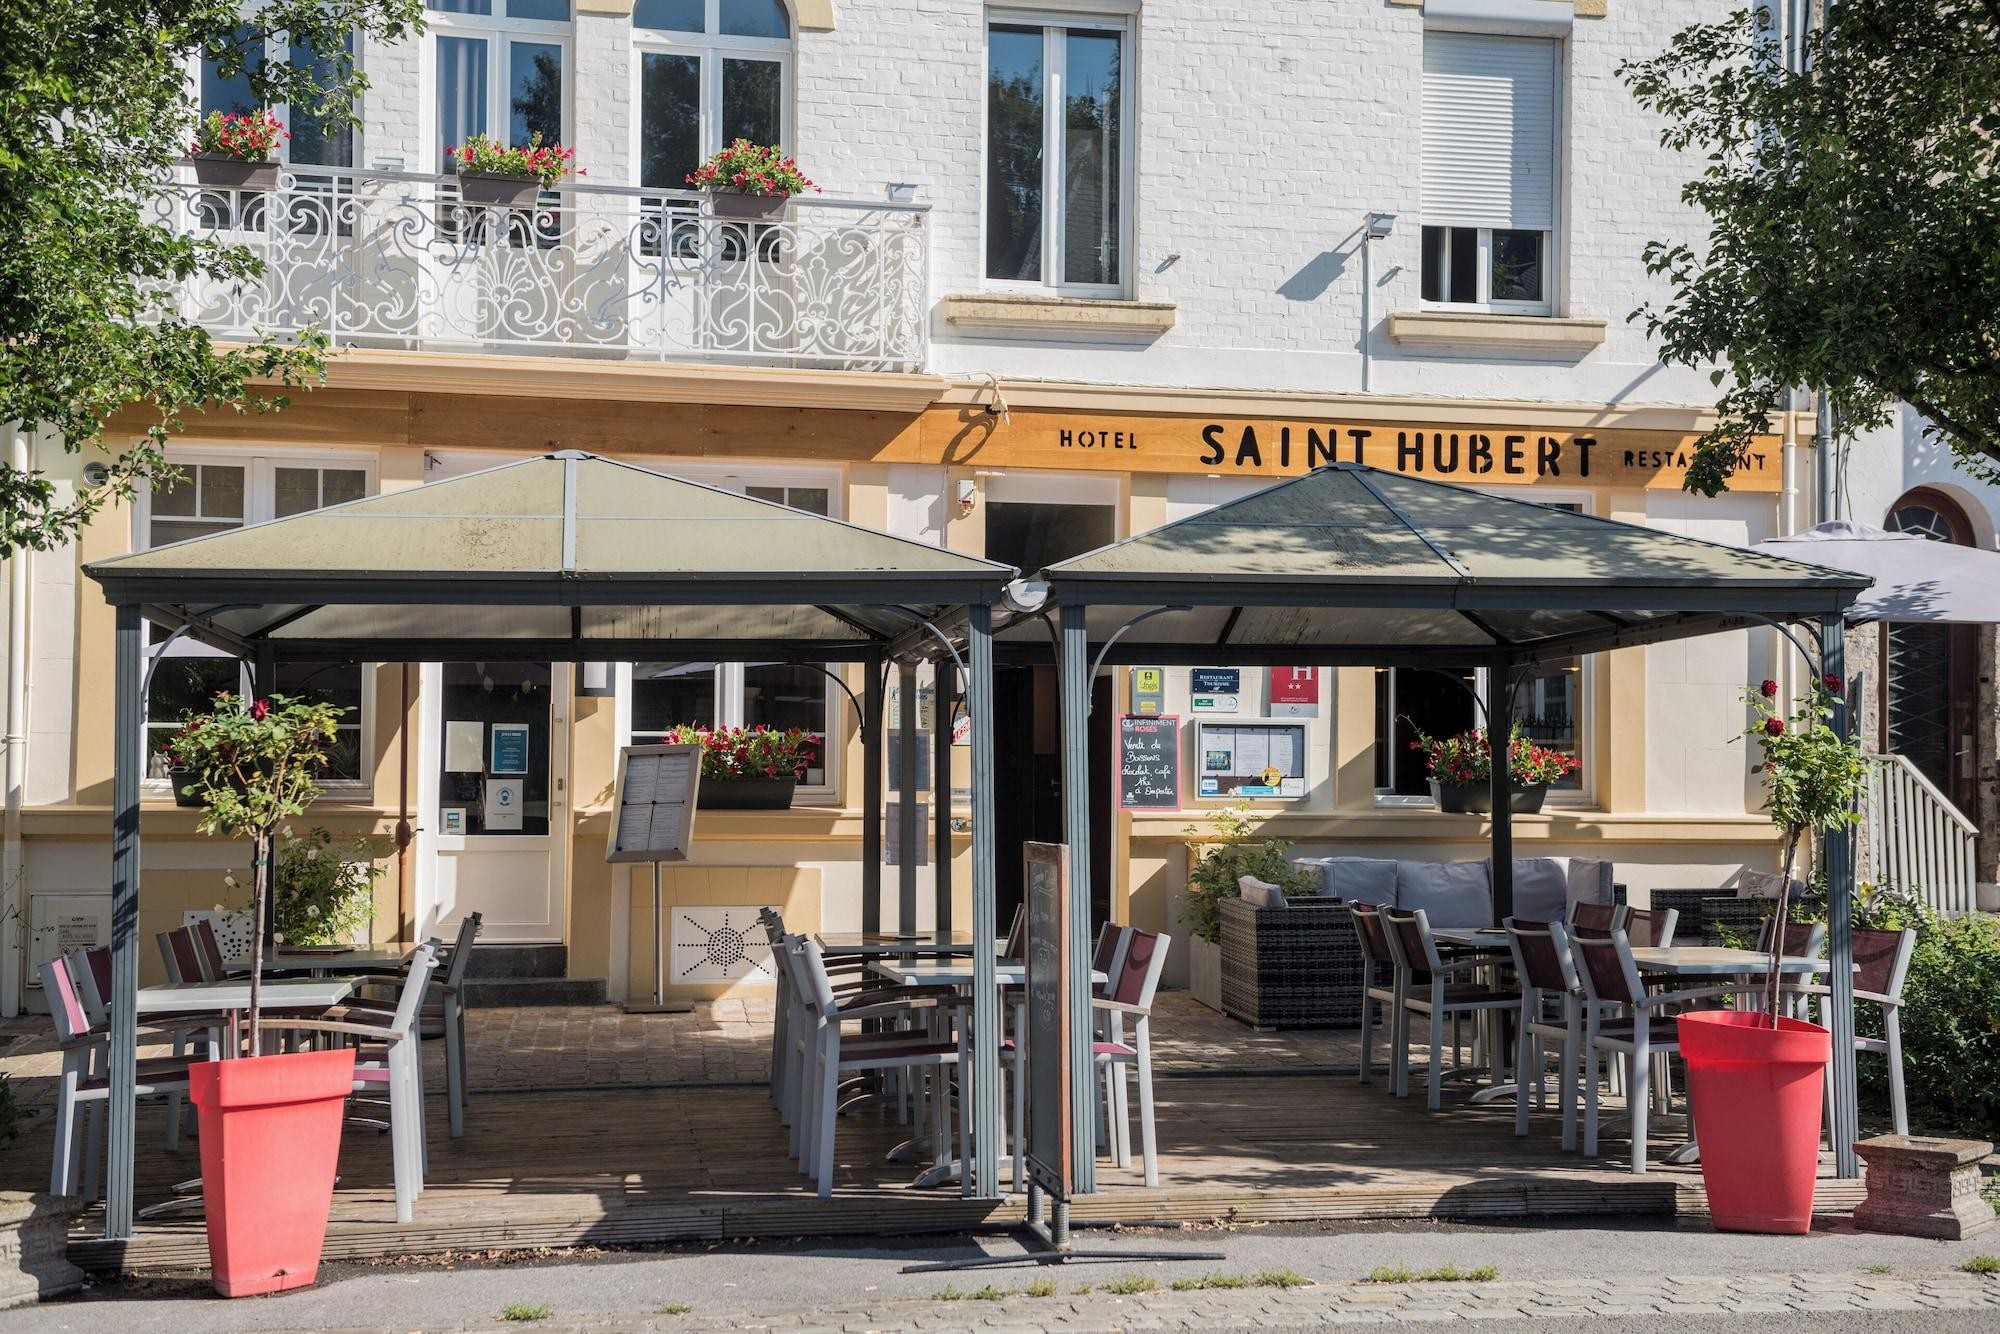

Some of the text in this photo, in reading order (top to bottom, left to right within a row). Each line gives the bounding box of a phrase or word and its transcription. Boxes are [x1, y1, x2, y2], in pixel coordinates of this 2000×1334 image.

[1060, 425, 1766, 477] HOTEL SAINT HUBERT RESTANT
[1291, 666, 1313, 680] H
[1134, 719, 1175, 727] INFINIMENT
[1124, 736, 1146, 750] Vente
[1154, 764, 1173, 780] café
